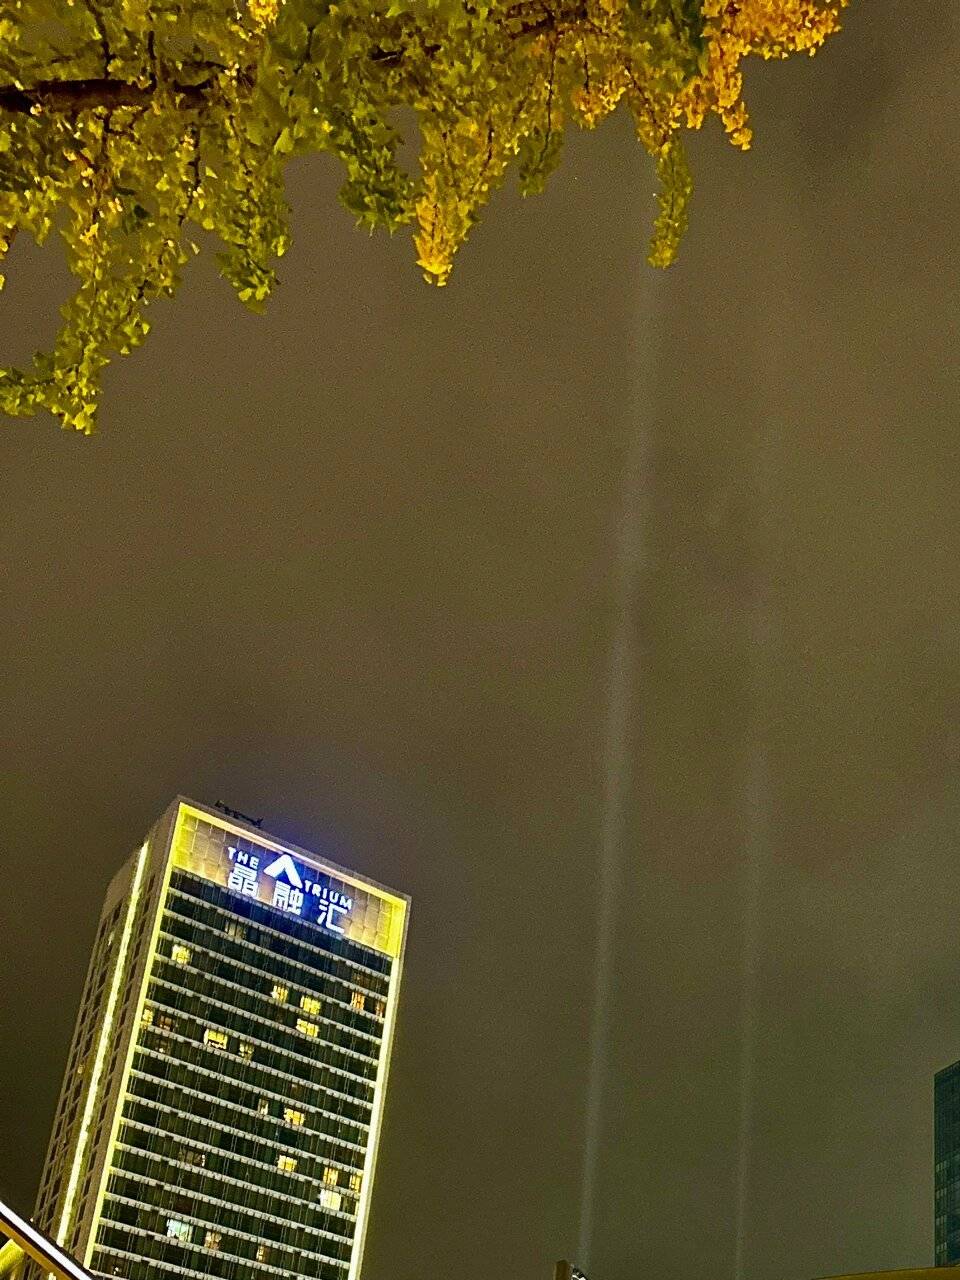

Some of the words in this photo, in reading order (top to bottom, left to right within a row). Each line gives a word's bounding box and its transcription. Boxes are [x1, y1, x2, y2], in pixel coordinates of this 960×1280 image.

[227, 846, 259, 869] THE
[228, 862, 347, 933] 晶融汇
